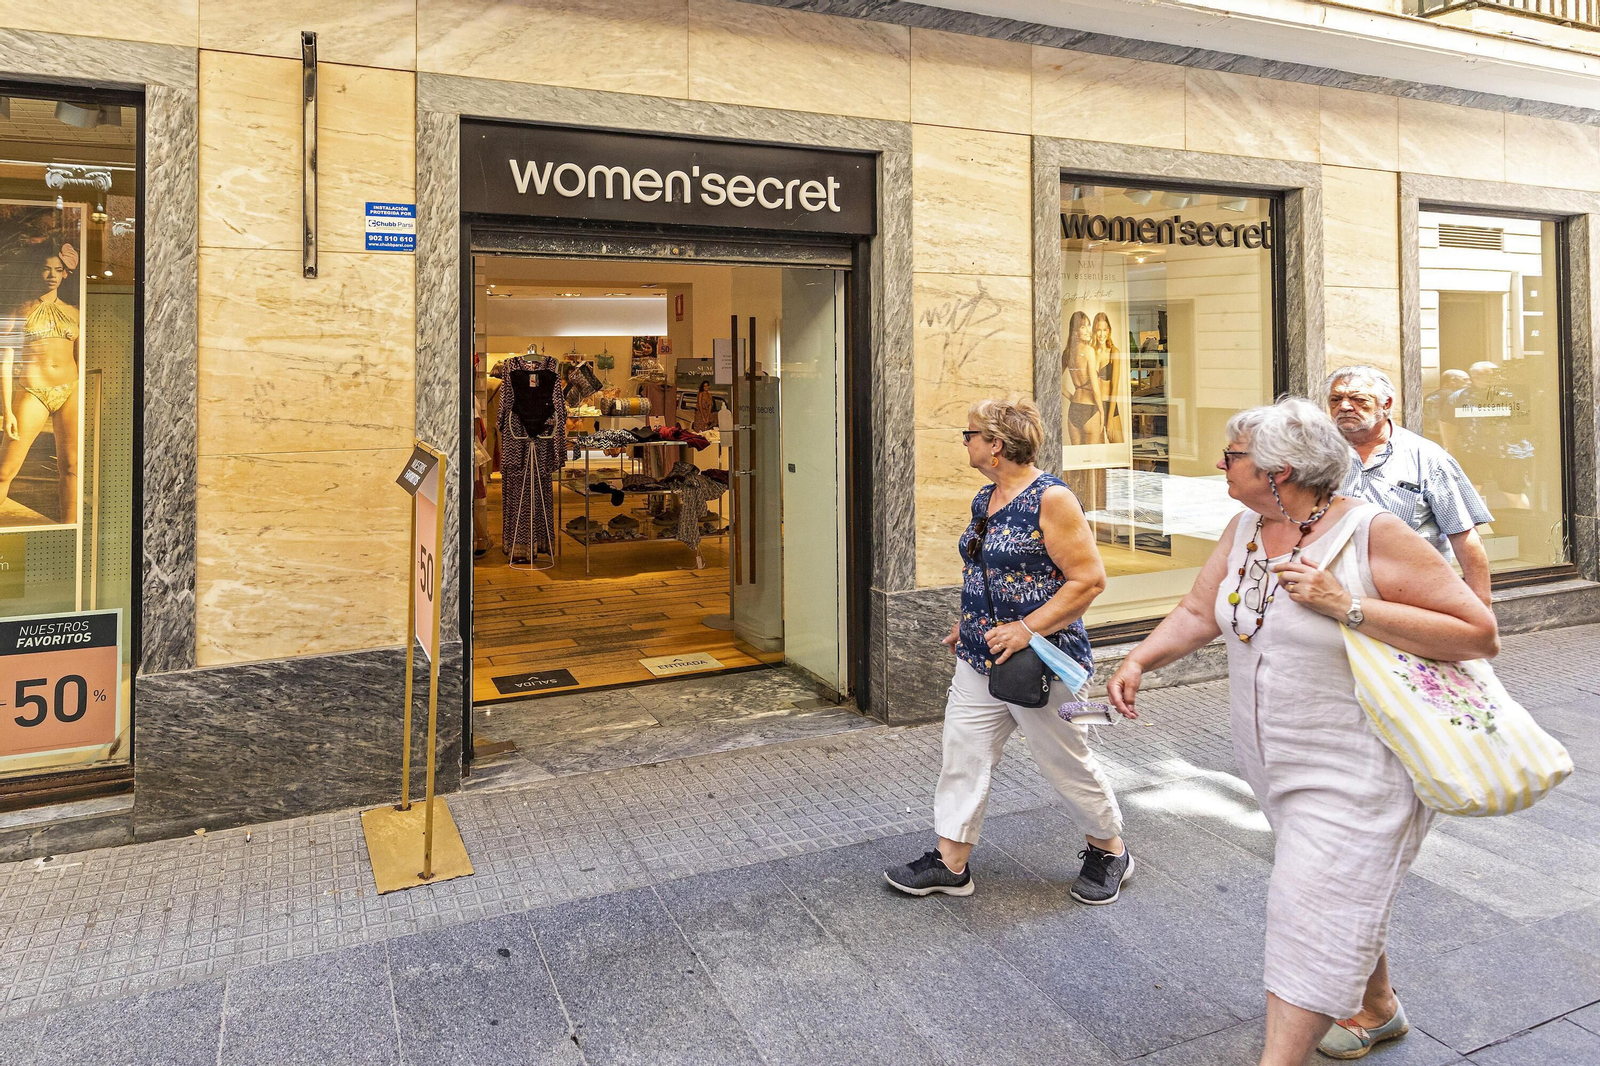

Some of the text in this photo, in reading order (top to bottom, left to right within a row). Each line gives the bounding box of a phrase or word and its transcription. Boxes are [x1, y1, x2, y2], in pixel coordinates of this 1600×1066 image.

[509, 158, 841, 213] women'secret
[1060, 212, 1272, 249] women'secret
[1074, 272, 1116, 281] essentials
[1477, 401, 1521, 412] essentials
[19, 620, 90, 637] NUESTROS
[16, 632, 92, 648] FAVORITOS
[657, 659, 708, 670] ENTRADA
[514, 678, 558, 688] SALIDA
